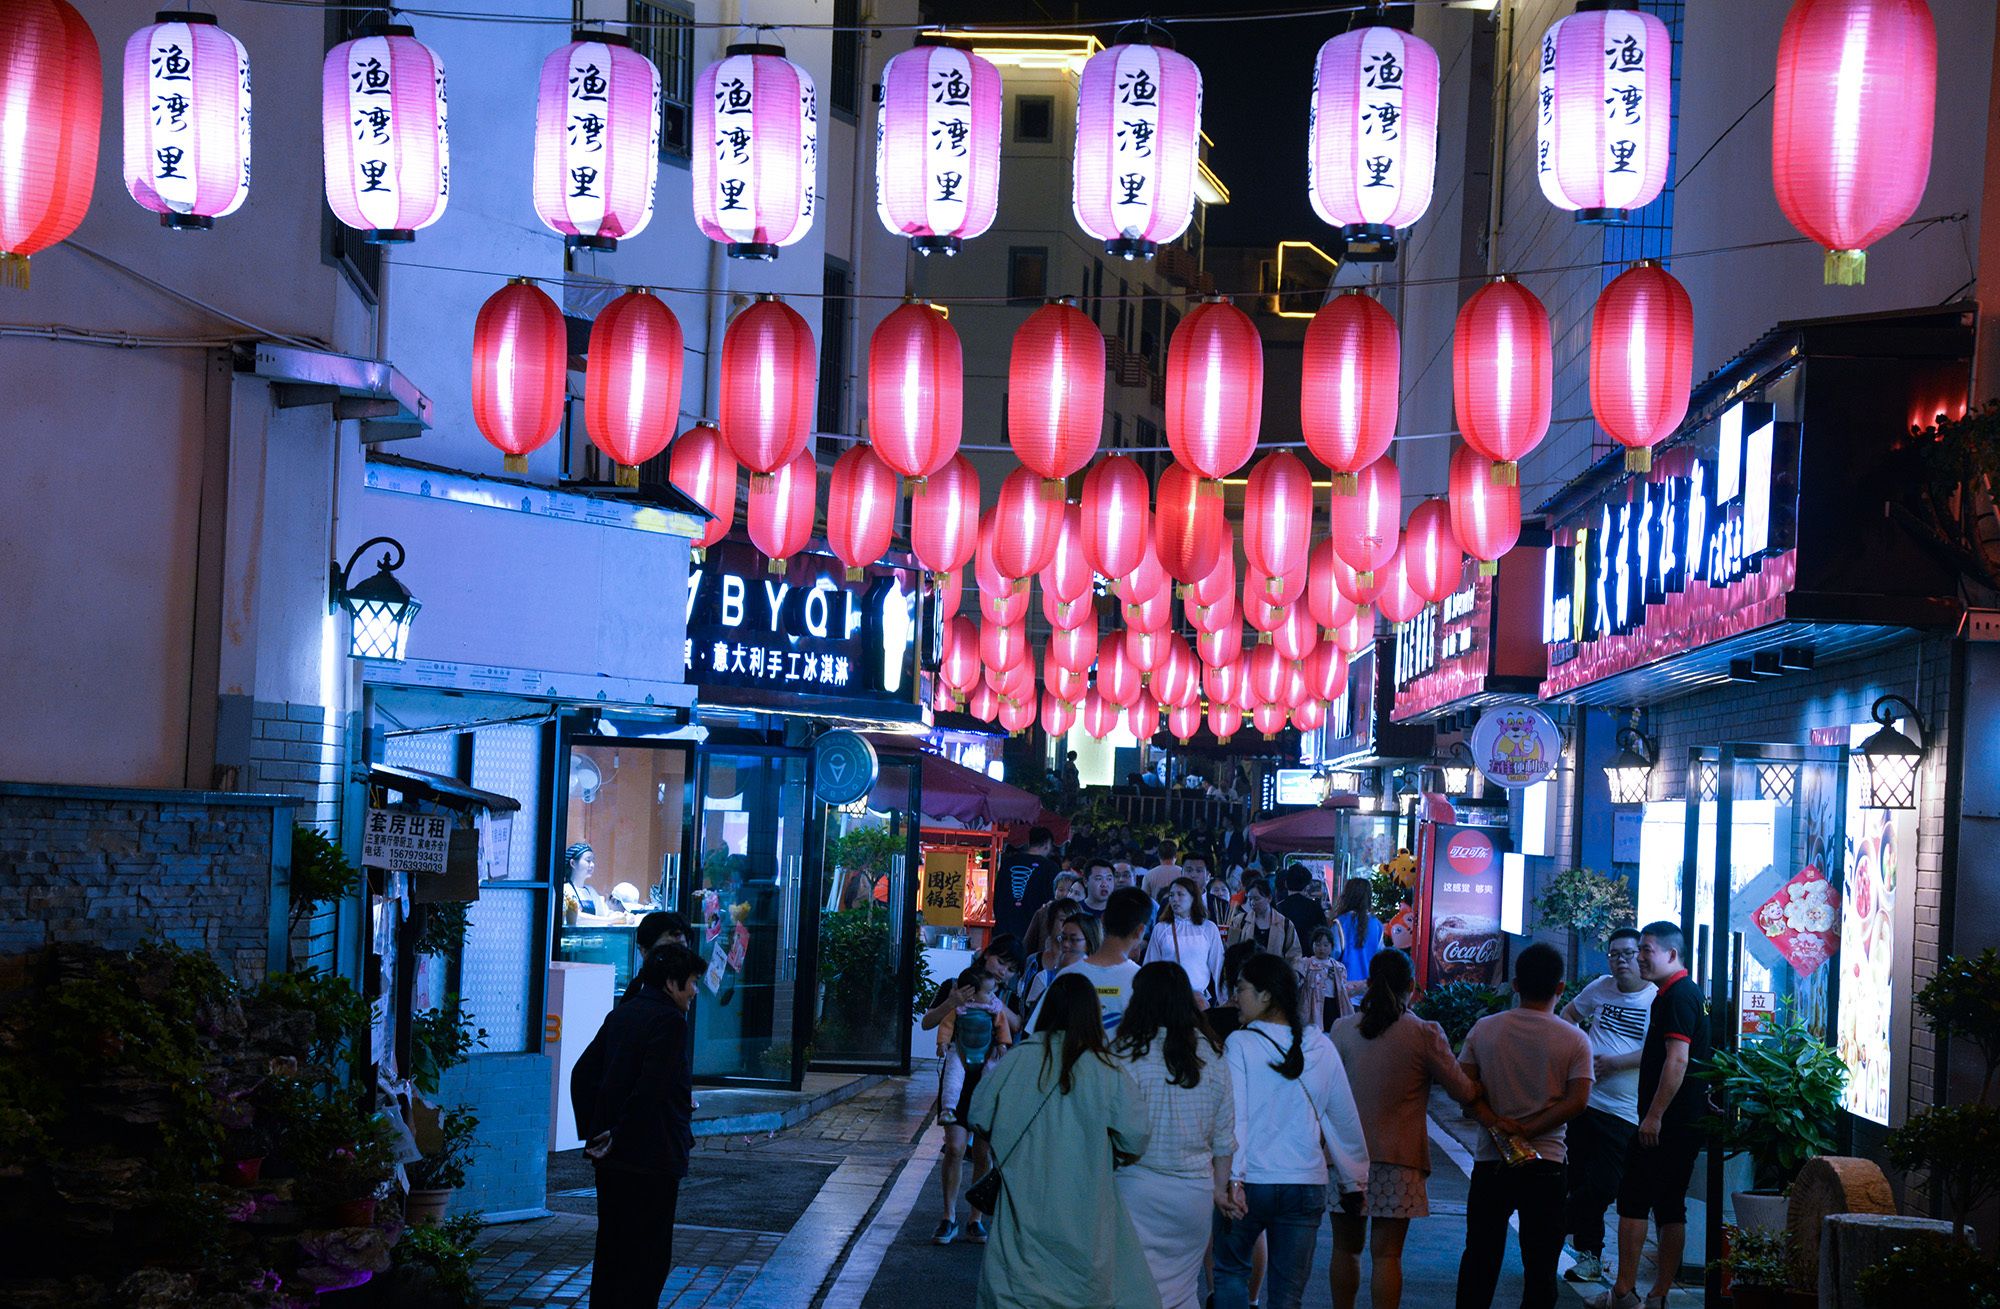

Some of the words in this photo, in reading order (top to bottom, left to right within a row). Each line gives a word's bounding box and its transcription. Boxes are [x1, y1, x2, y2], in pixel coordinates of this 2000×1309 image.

[152, 46, 191, 180] 渔湾里
[351, 56, 392, 193] 渔湾里
[567, 64, 608, 199] 渔湾里
[716, 77, 753, 211] 渔湾里
[932, 68, 971, 203] 渔湾里
[1117, 68, 1157, 206] 渔湾里
[1362, 52, 1403, 188] 渔湾里
[1605, 34, 1646, 175] 渔湾里
[370, 812, 446, 839] 套房出租
[388, 859, 443, 872] 13763939039
[389, 849, 443, 862] 15679793433
[1443, 882, 1470, 893] 这感觉
[1475, 884, 1493, 894] 够爽
[1450, 846, 1490, 858] 可口可乐
[1751, 994, 1766, 1009] 拉
